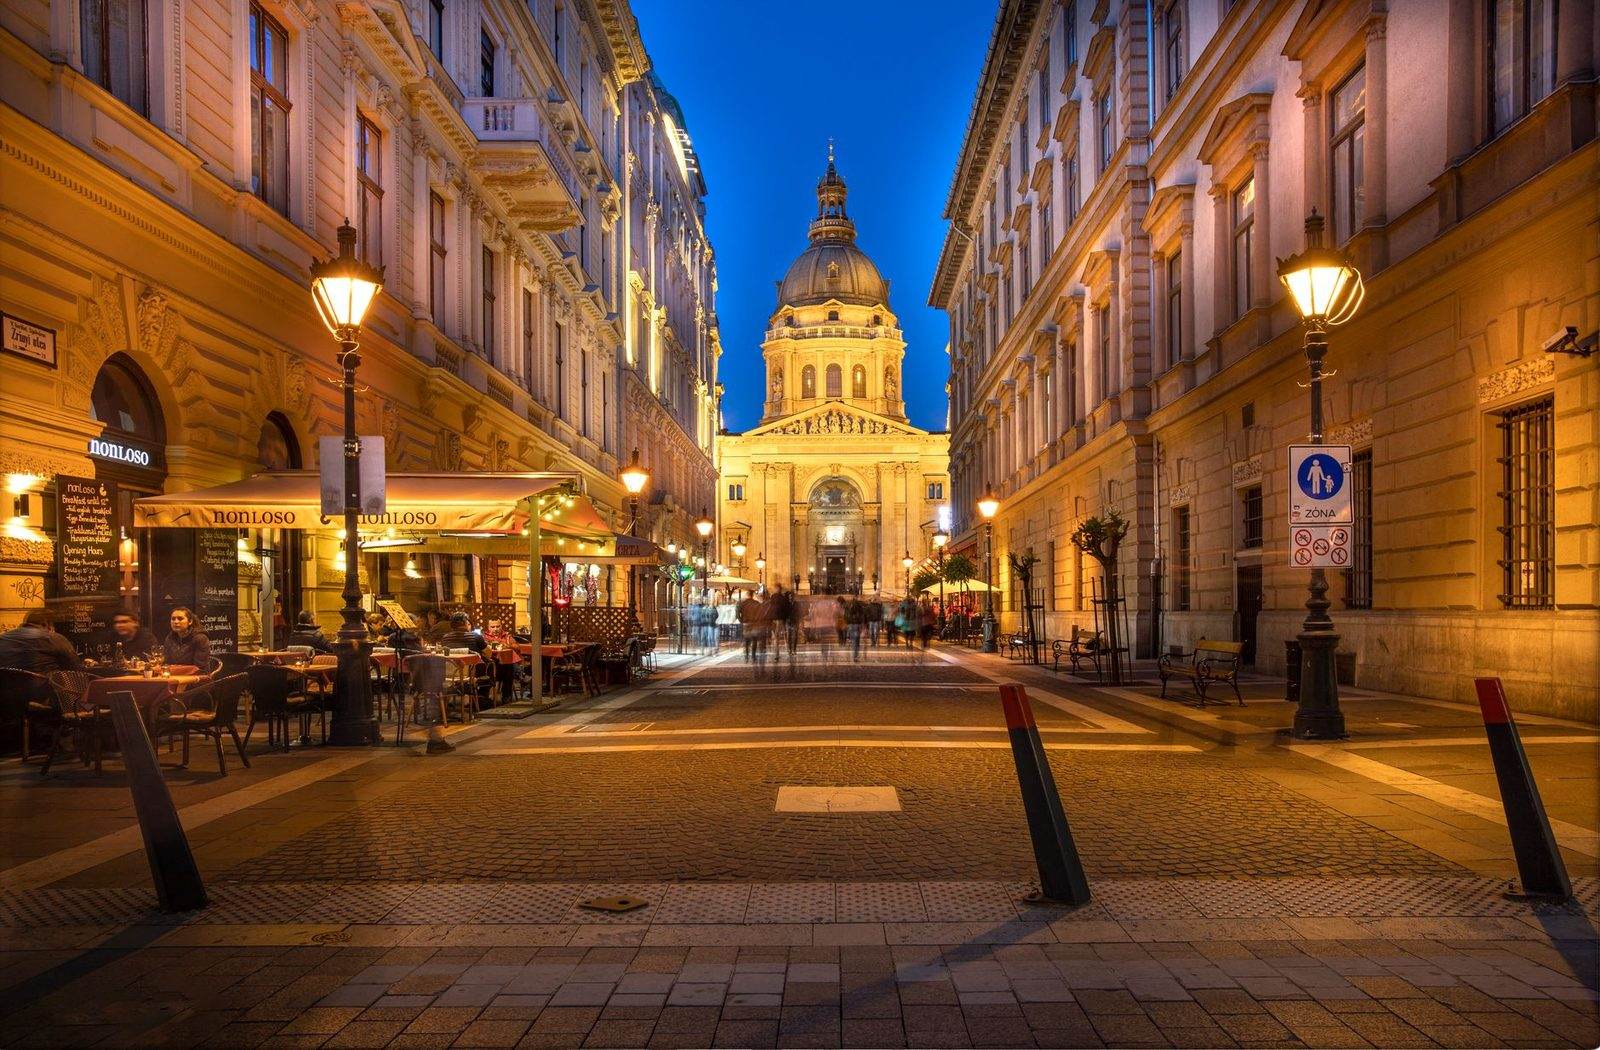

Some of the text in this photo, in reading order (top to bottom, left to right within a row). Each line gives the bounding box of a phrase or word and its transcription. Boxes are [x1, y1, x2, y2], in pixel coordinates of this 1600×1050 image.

[1305, 506, 1336, 518] ZÓNA
[63, 544, 104, 557] Opening Hours
